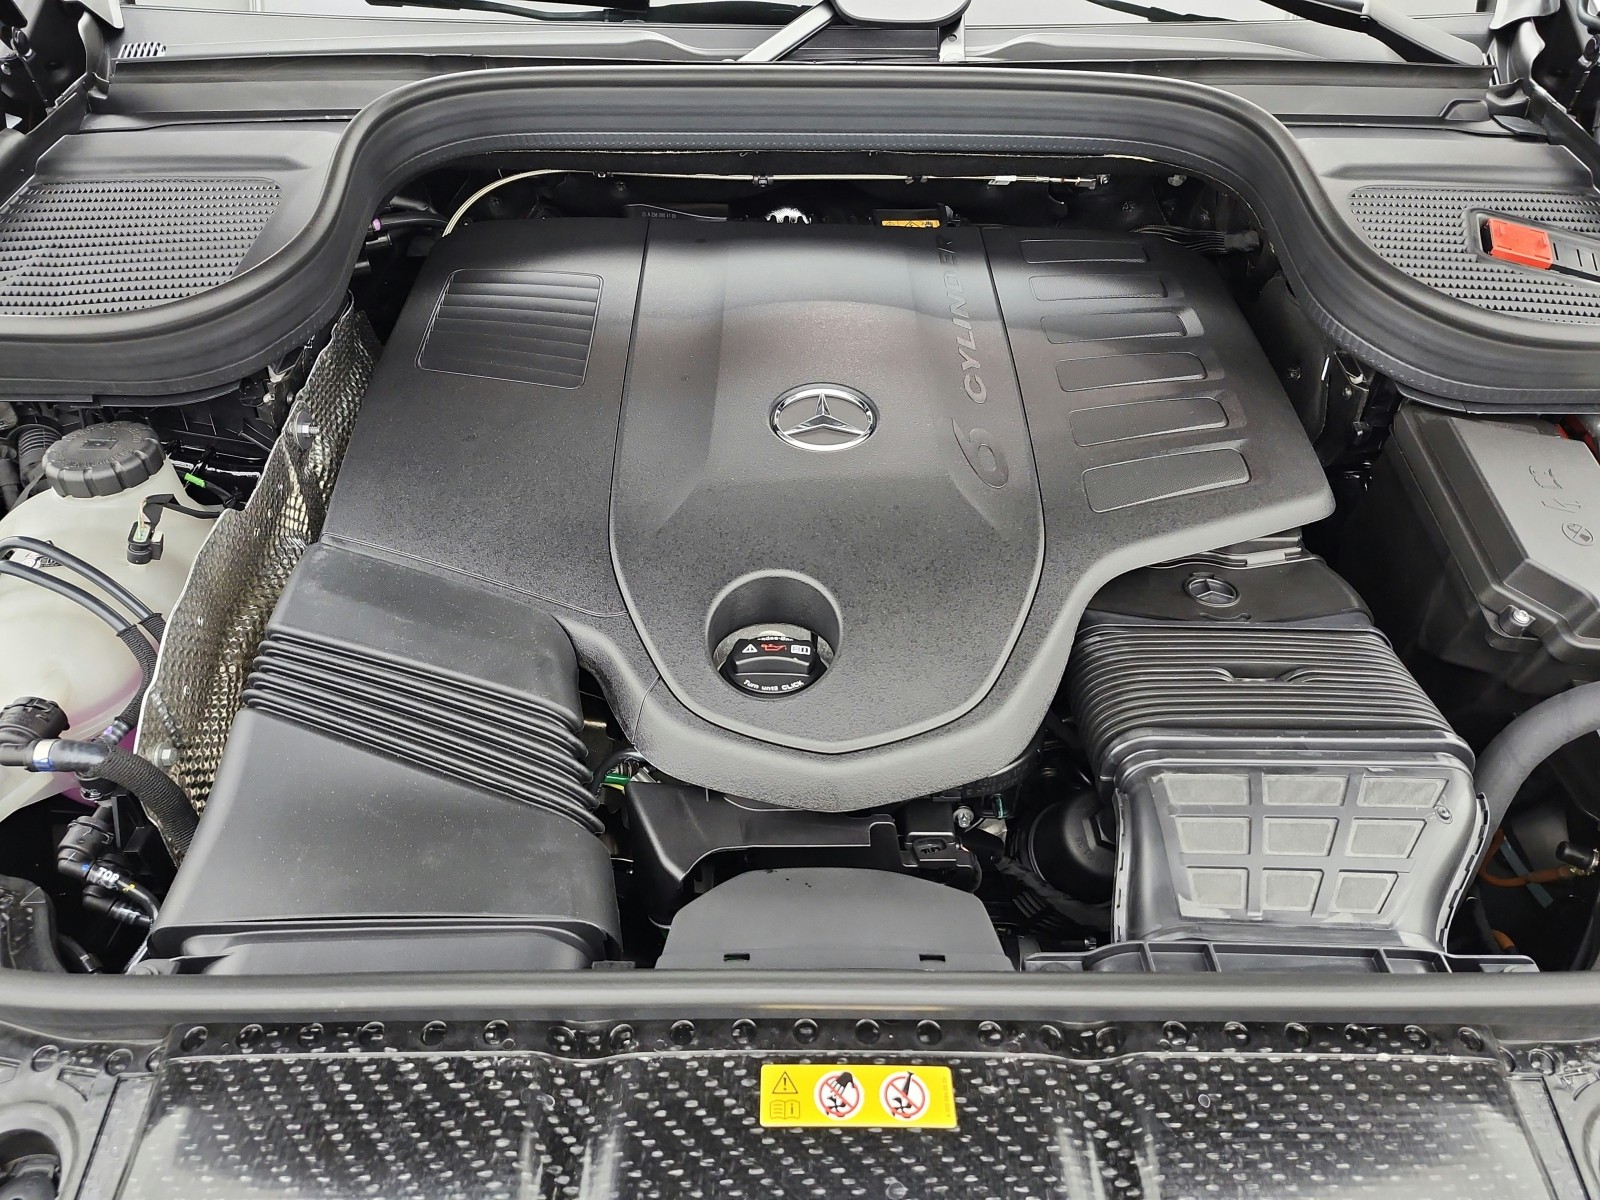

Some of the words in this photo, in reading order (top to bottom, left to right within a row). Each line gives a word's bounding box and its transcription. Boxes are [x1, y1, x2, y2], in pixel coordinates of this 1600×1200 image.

[936, 235, 988, 405] CYLINDER
[951, 417, 1010, 489] 6
[743, 680, 759, 689] Turn
[781, 680, 804, 690] CLICK
[98, 866, 119, 882] TOP
